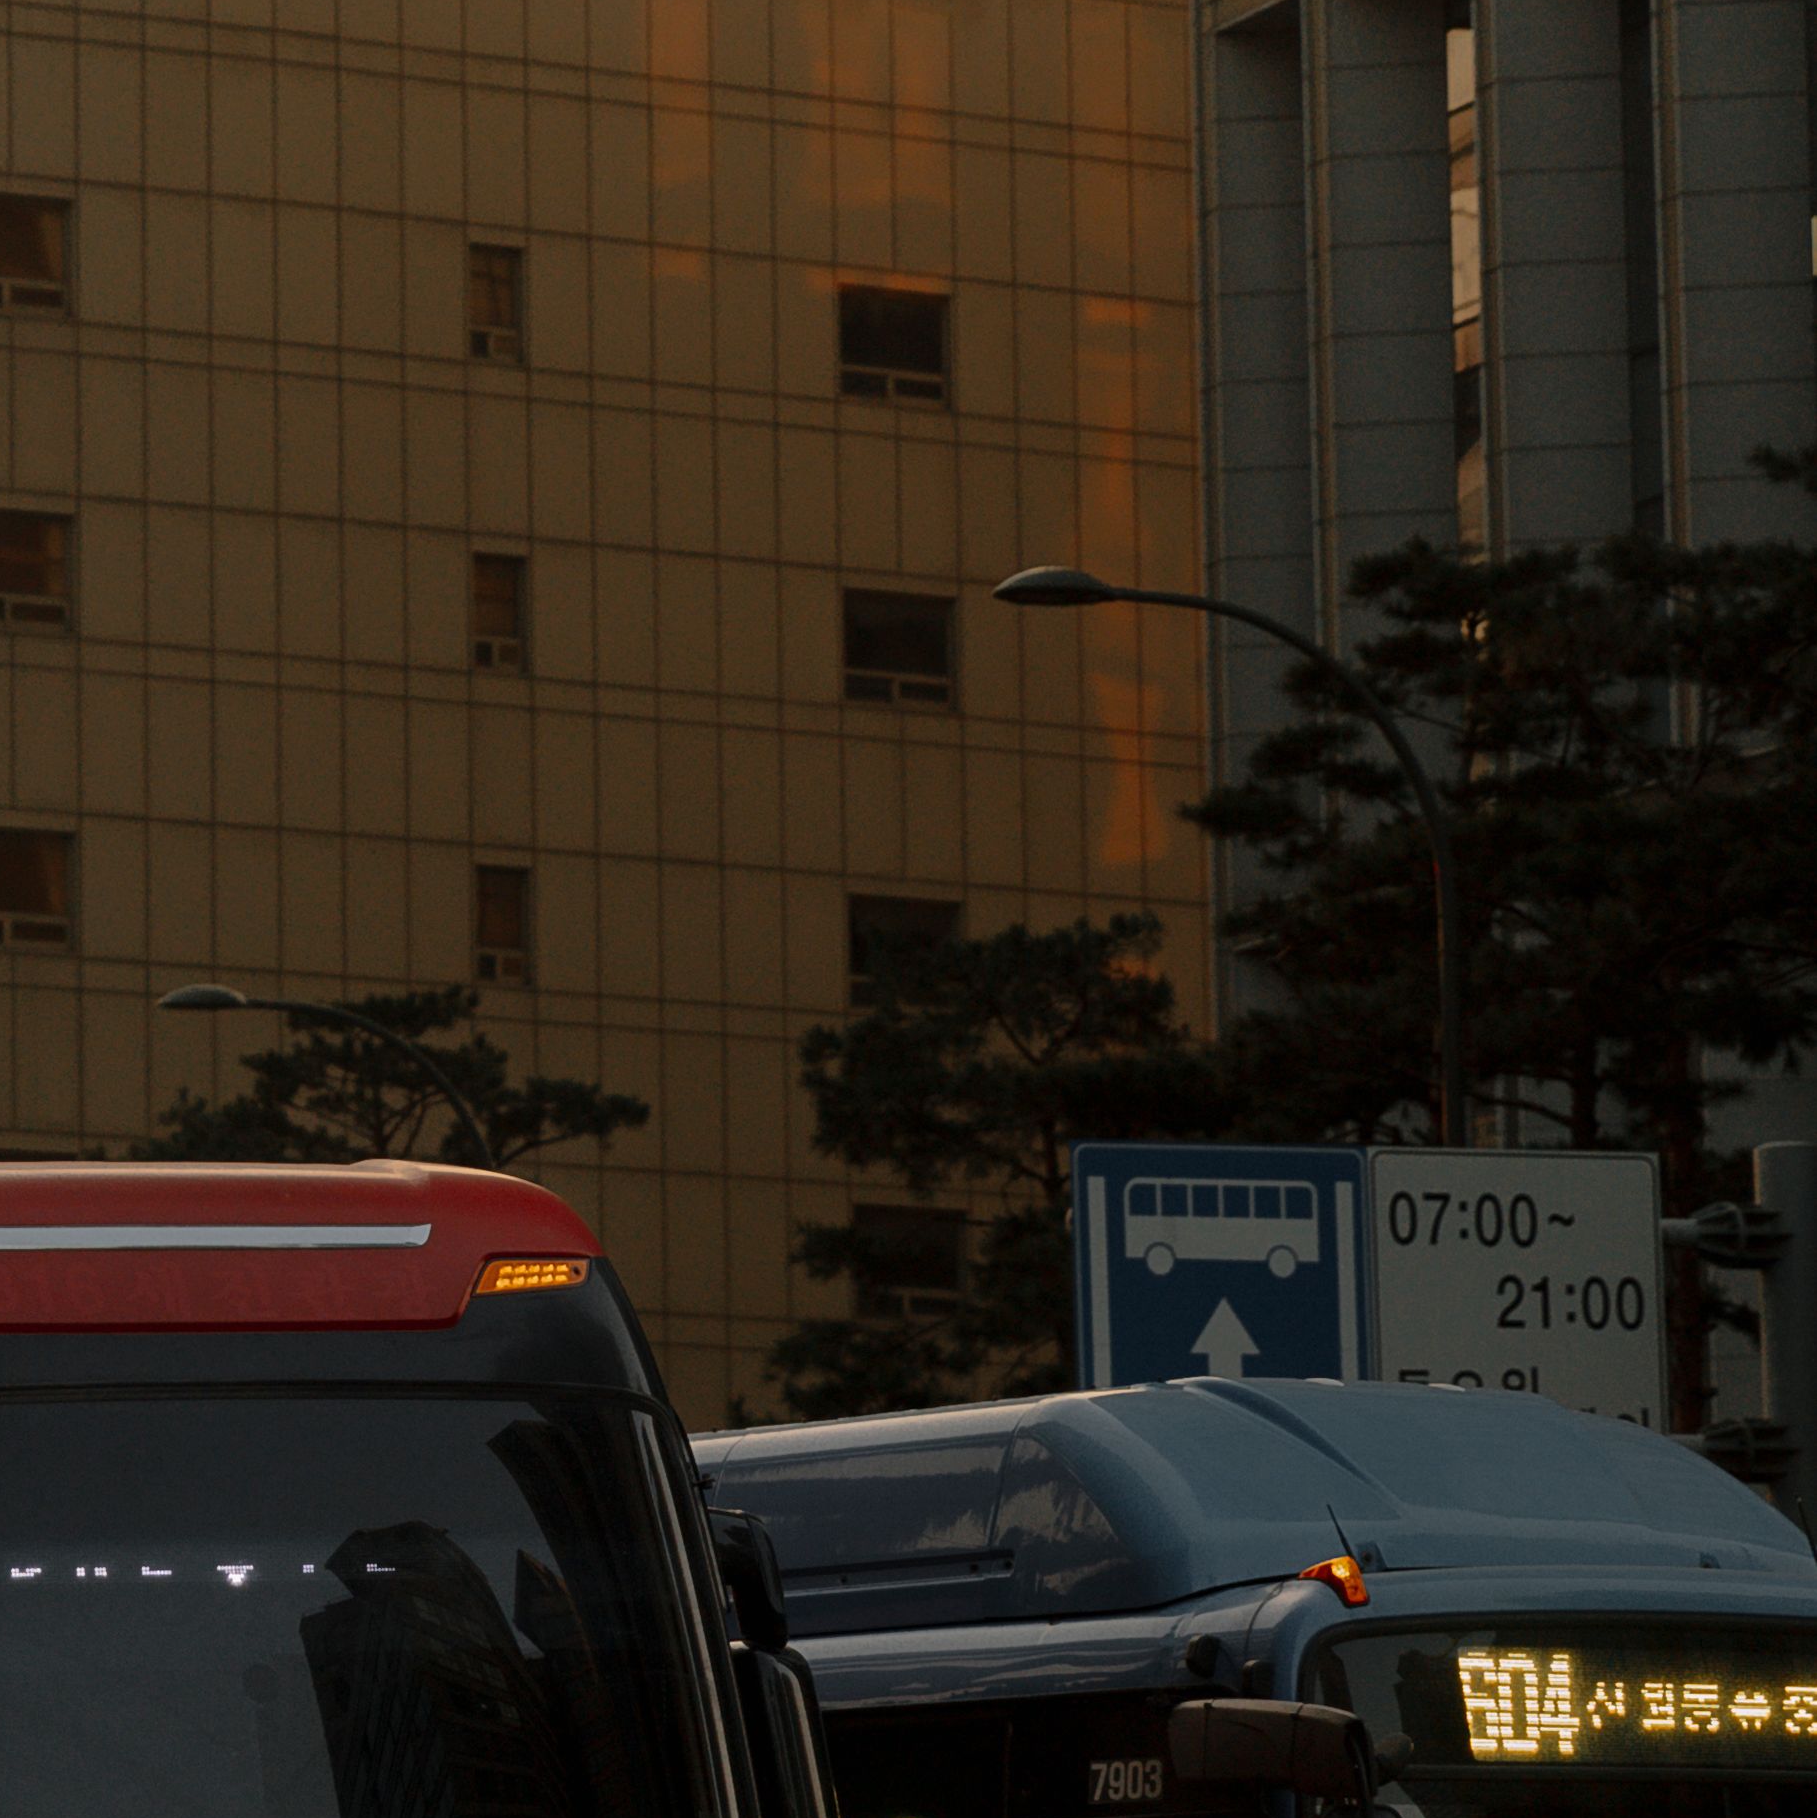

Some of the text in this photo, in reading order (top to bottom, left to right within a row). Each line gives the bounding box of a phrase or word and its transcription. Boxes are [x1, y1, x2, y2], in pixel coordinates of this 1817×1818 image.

[1388, 1191, 1576, 1248] 07:00~
[1495, 1275, 1645, 1331] 21:00
[1089, 1759, 1164, 1802] 7903
